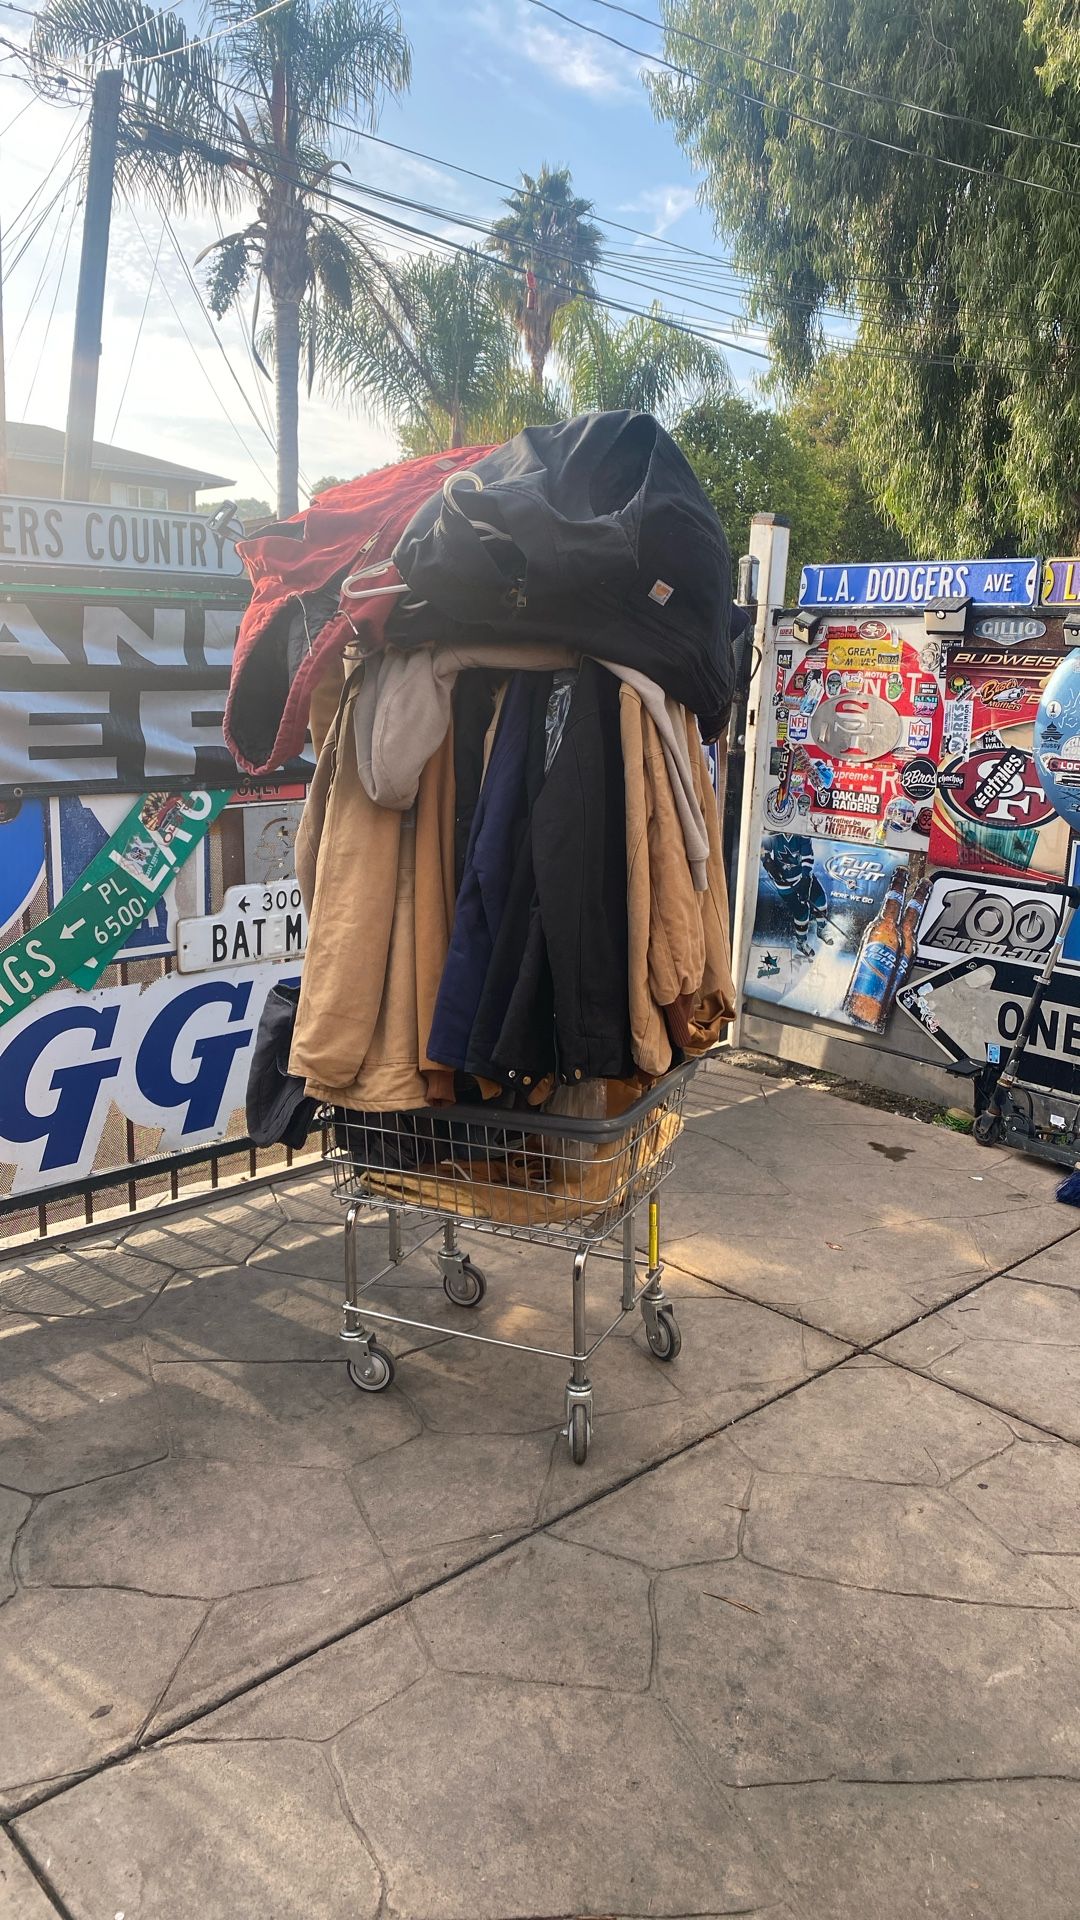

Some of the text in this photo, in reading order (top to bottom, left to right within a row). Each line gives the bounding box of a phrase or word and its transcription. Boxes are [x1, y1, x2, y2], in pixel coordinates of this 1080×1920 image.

[85, 512, 226, 569] COUNTRY
[816, 566, 1014, 602] L.A. DODGERS AVE
[981, 621, 1037, 635] GILLIG
[778, 654, 791, 665] CAT
[847, 647, 877, 657] GREAT
[790, 716, 807, 727] NFL
[911, 724, 929, 736] NFL
[985, 742, 1005, 750] WALL
[777, 736, 795, 781] CHEVY
[833, 771, 869, 780] upreme
[832, 790, 880, 805] OAKLAND
[832, 801, 878, 813] RAIDERS
[824, 821, 872, 838] HUNTING
[842, 856, 883, 871] BUD
[832, 866, 885, 882] LIGHT
[97, 877, 128, 905] PL
[830, 890, 874, 905] HERE WE GO
[262, 890, 301, 911] 300
[94, 897, 145, 945] 6500
[212, 918, 266, 963] BAT
